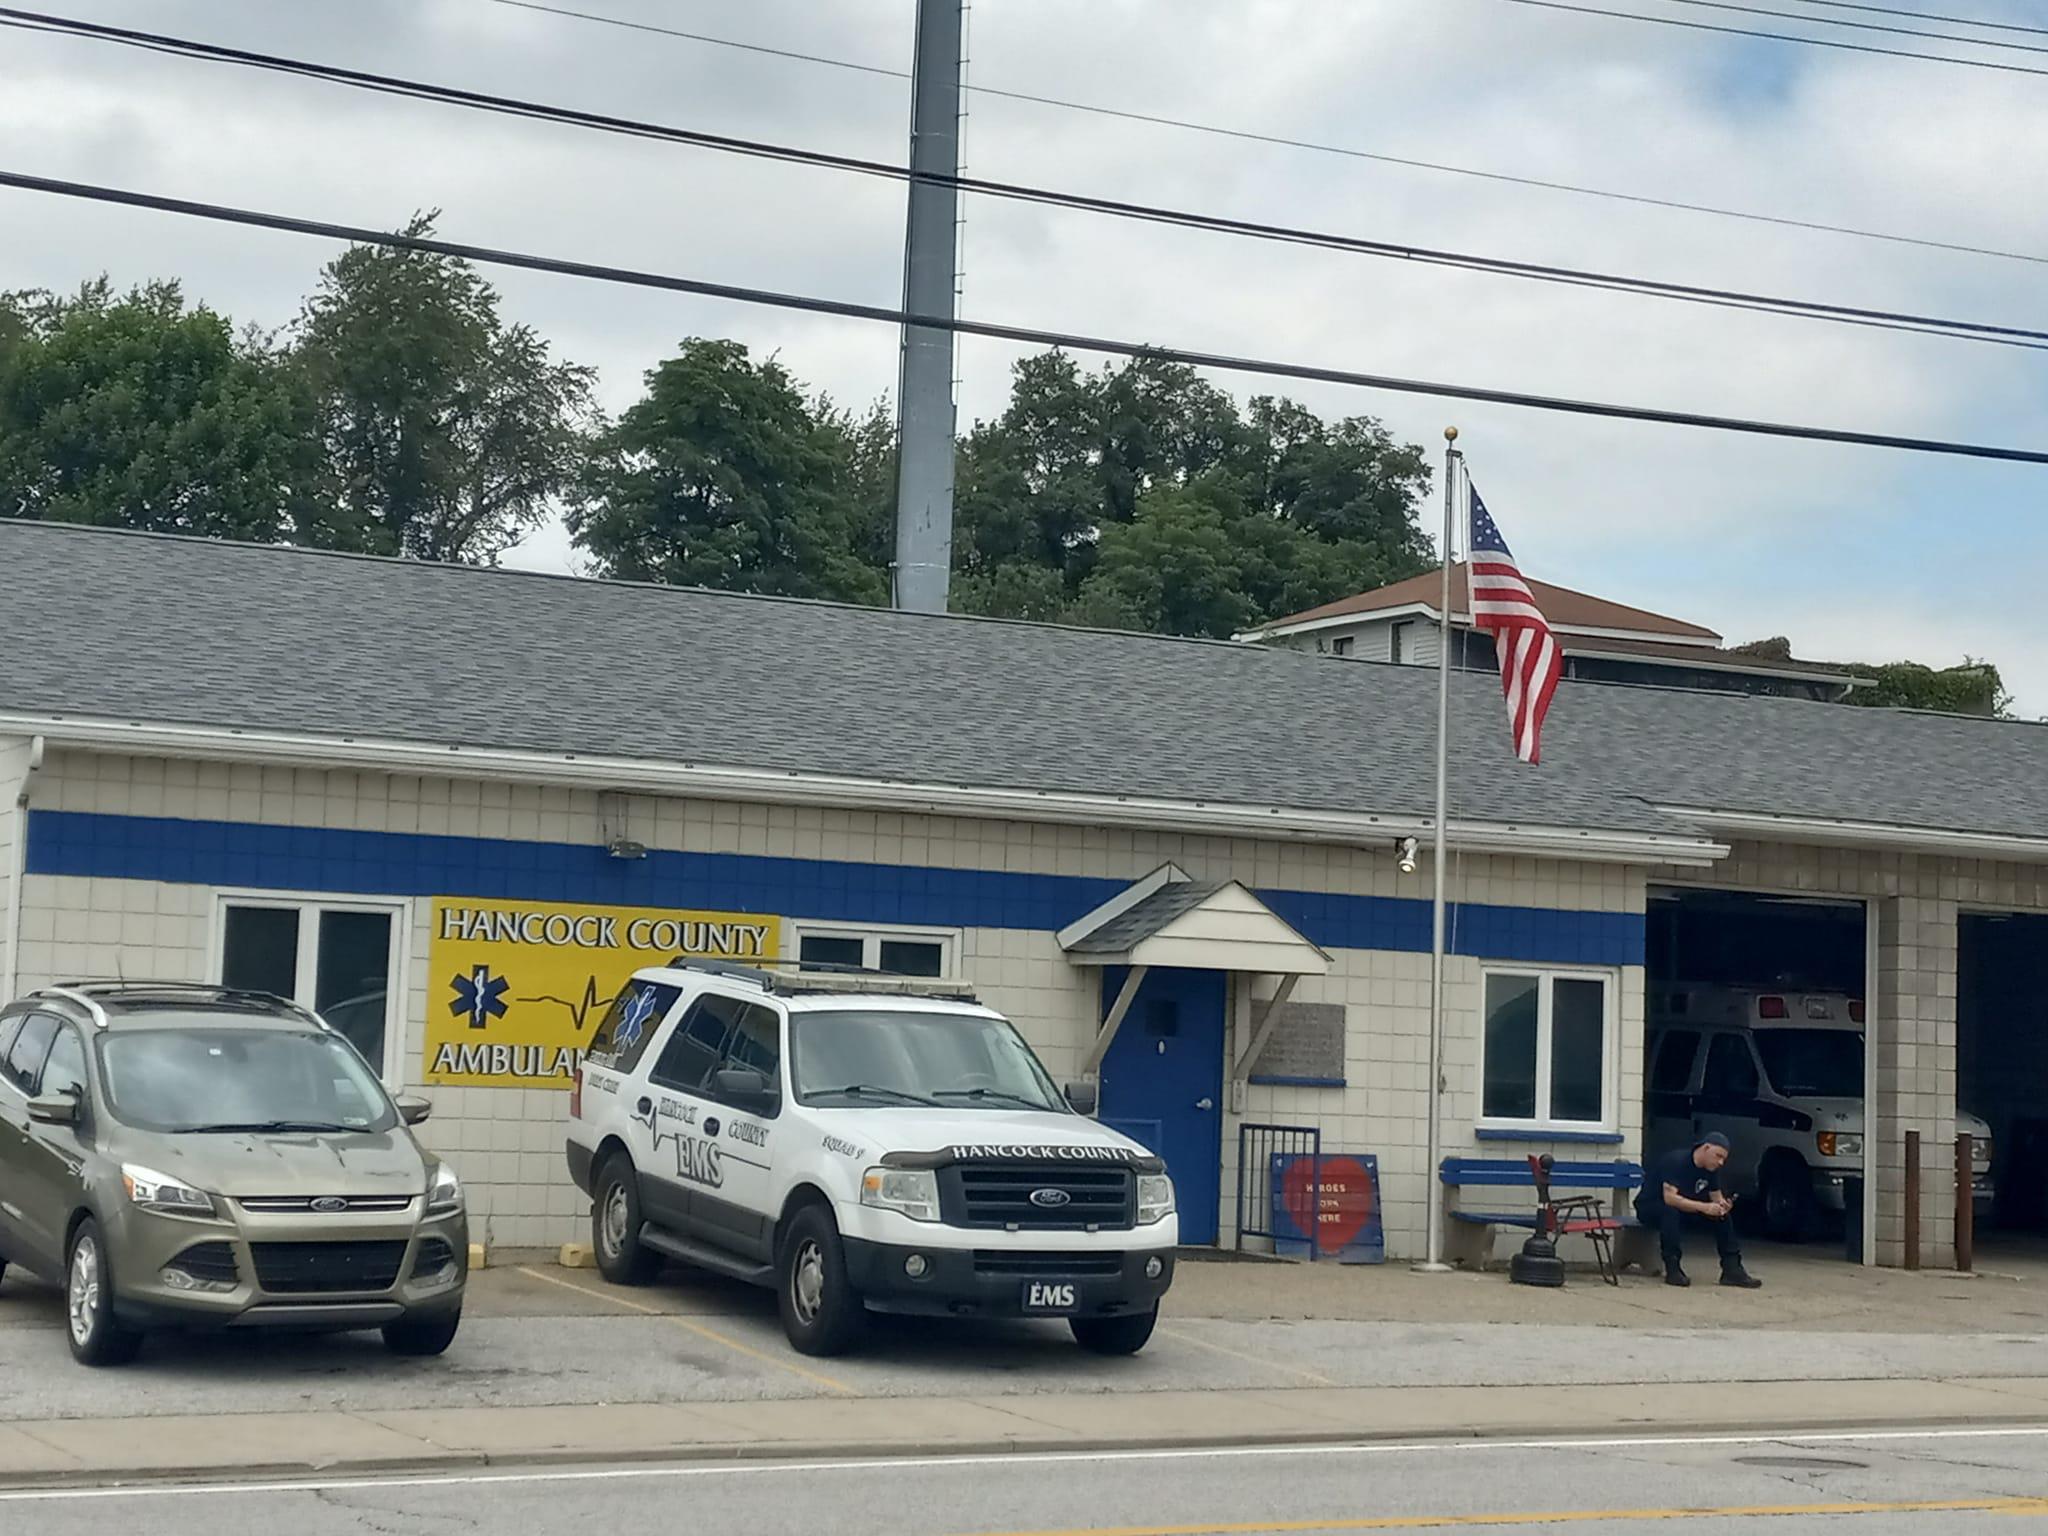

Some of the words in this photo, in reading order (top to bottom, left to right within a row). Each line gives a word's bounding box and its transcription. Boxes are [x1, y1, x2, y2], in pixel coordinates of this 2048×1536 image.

[440, 908, 619, 948] HANCOCK
[627, 918, 770, 955] COUNTY
[728, 1119, 770, 1148] COUNTY
[674, 1132, 724, 1189] EMS
[952, 1145, 1054, 1159] HANCOCK
[1058, 1147, 1130, 1161] COUNTY
[1305, 1183, 1347, 1193] HROES
[1029, 1284, 1075, 1306] EMS
